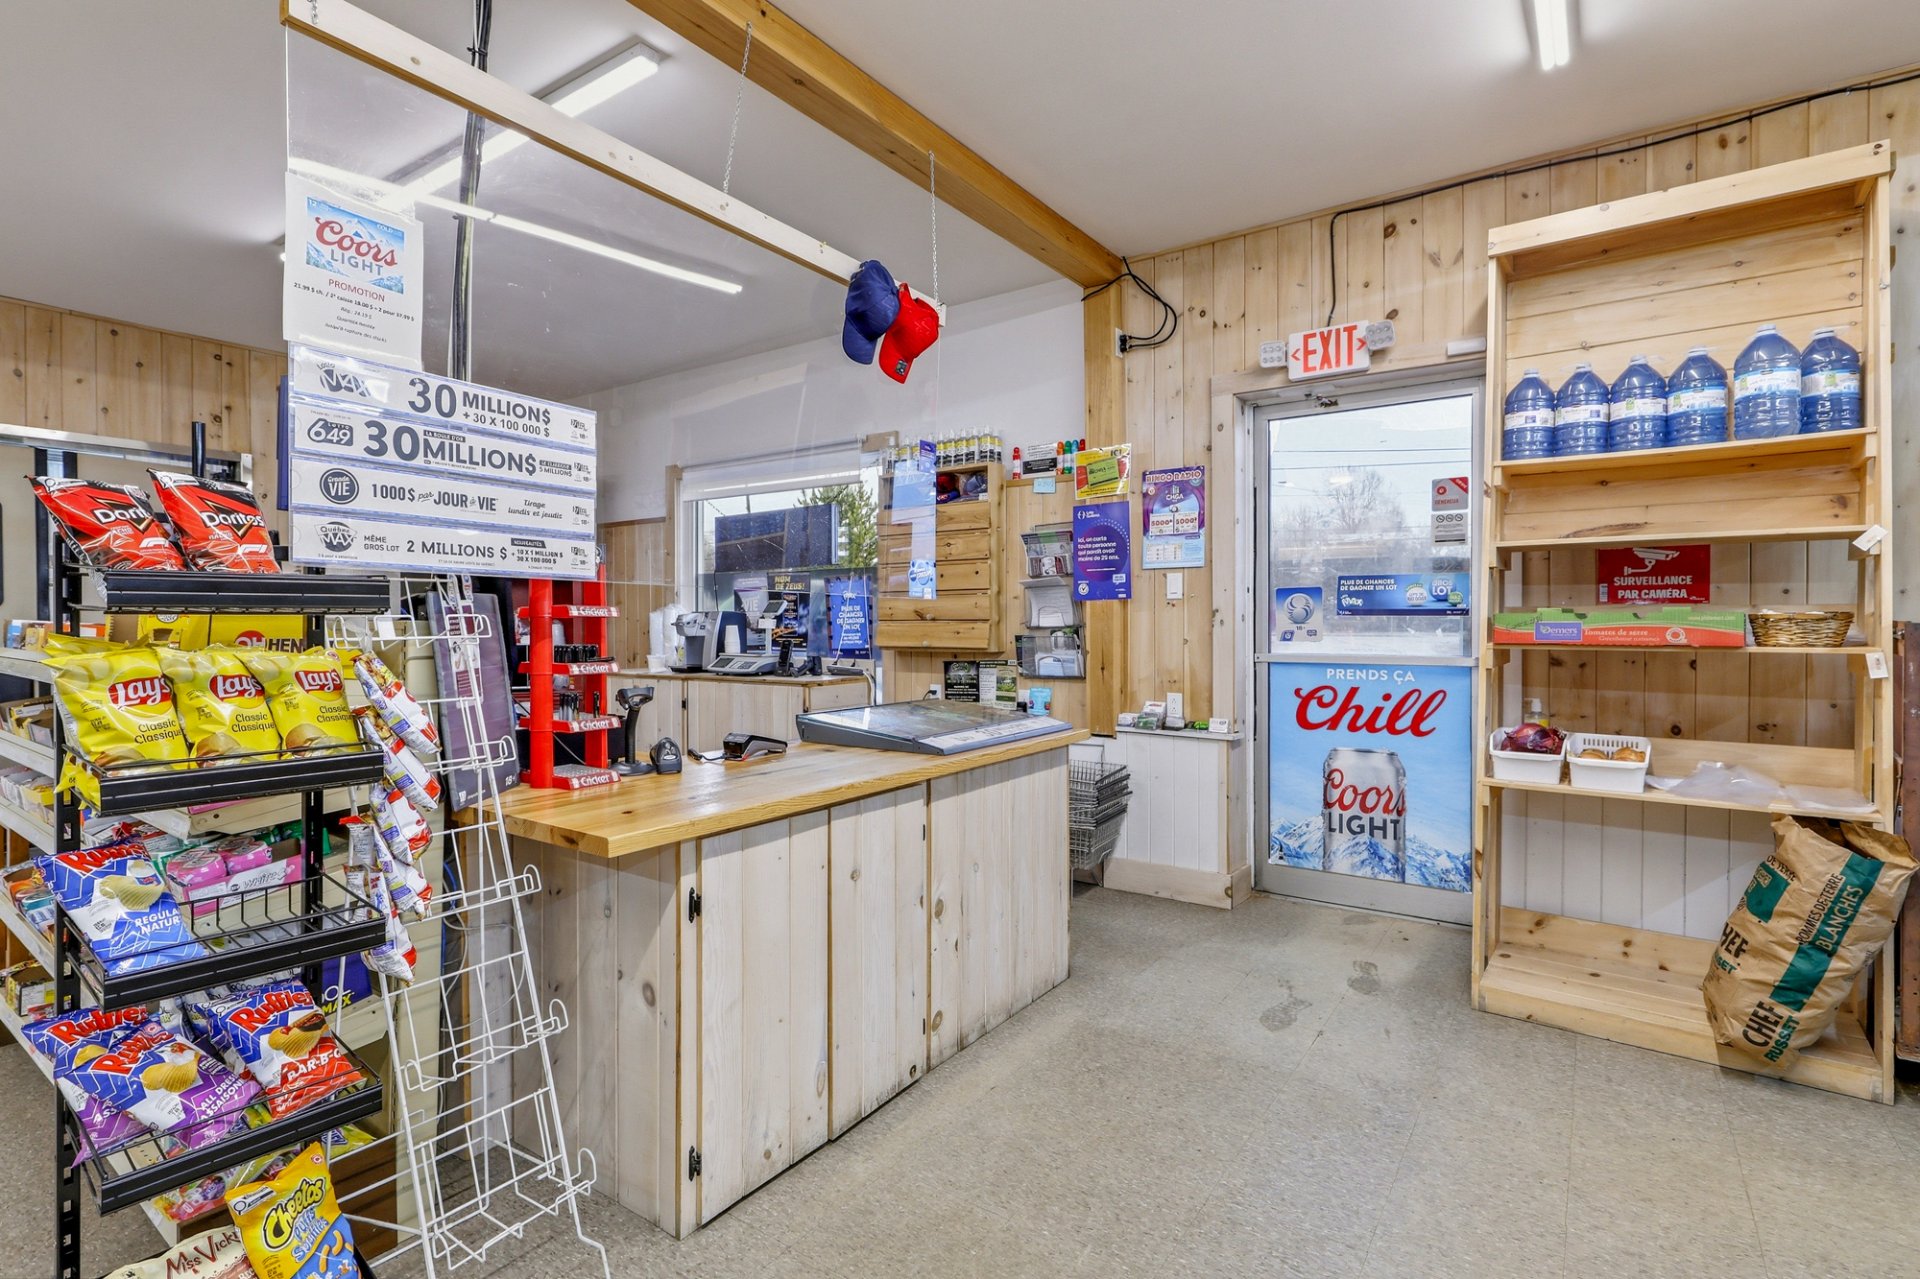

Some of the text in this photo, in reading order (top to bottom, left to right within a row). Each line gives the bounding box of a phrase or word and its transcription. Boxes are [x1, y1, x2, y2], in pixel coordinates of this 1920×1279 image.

[315, 216, 398, 267] Coors
[330, 249, 383, 276] LIGHT
[328, 278, 385, 302] PROMOTION
[1302, 325, 1357, 373] EXIT
[408, 377, 456, 418] 30
[463, 411, 470, 419] +
[473, 412, 486, 424] 30
[500, 418, 519, 431] 100
[522, 423, 541, 436] 000
[544, 427, 550, 438] $
[308, 420, 420, 462] 649 30
[1145, 470, 1202, 484] BINGO RADIO
[328, 481, 350, 497] VIE
[372, 484, 416, 503] 1000$
[418, 491, 434, 502] par
[434, 490, 468, 508] JOUR
[478, 496, 496, 512] VIE
[524, 500, 546, 509] Tirage
[92, 506, 152, 524] Dorit
[200, 510, 265, 528] Doritos
[508, 507, 530, 516] lundis
[320, 525, 350, 534] Québec
[364, 534, 386, 544] MÊME
[364, 544, 385, 552] GROS
[406, 540, 508, 560] 2 MILLIONS $
[1613, 575, 1693, 586] SURVEILLANCE
[1432, 586, 1452, 596] LOT
[1618, 589, 1639, 599] PAR
[1641, 588, 1688, 599] CAMÉRA
[580, 606, 608, 616] Cricket
[1540, 624, 1578, 634] Demers
[1584, 628, 1616, 636] Tomates
[1618, 628, 1627, 636] de
[268, 638, 305, 654] HEN
[580, 663, 609, 674] Cricket
[1326, 668, 1416, 685] PRENDS ÇA
[115, 674, 171, 707] Lay's
[216, 674, 262, 704] Lay's
[302, 669, 340, 697] Lay's
[316, 712, 352, 723] Classiqu
[319, 704, 347, 714] Classic
[1294, 684, 1448, 738] Chill
[138, 718, 176, 734] Classic
[231, 721, 275, 732] Classique
[235, 712, 268, 724] Classic
[580, 718, 610, 730] Cricket
[134, 729, 183, 744] Classique
[580, 774, 610, 786] Cricket
[1323, 768, 1408, 818] Coors
[1328, 812, 1401, 841] LIGHT
[1795, 909, 1822, 945] POMMES
[1825, 872, 1844, 902] TERRE
[135, 909, 179, 927] REGULA
[140, 916, 180, 934] NATUR
[1815, 886, 1864, 950] BLANCHES
[1720, 922, 1748, 959] HEF
[1742, 1001, 1785, 1048] CHEF
[1764, 1015, 1800, 1062] RUSSET
[200, 1094, 217, 1110] ALL
[94, 1108, 119, 1124] ASS
[264, 1178, 325, 1250] Cheetos
[166, 1231, 241, 1278] Miss Vicki
